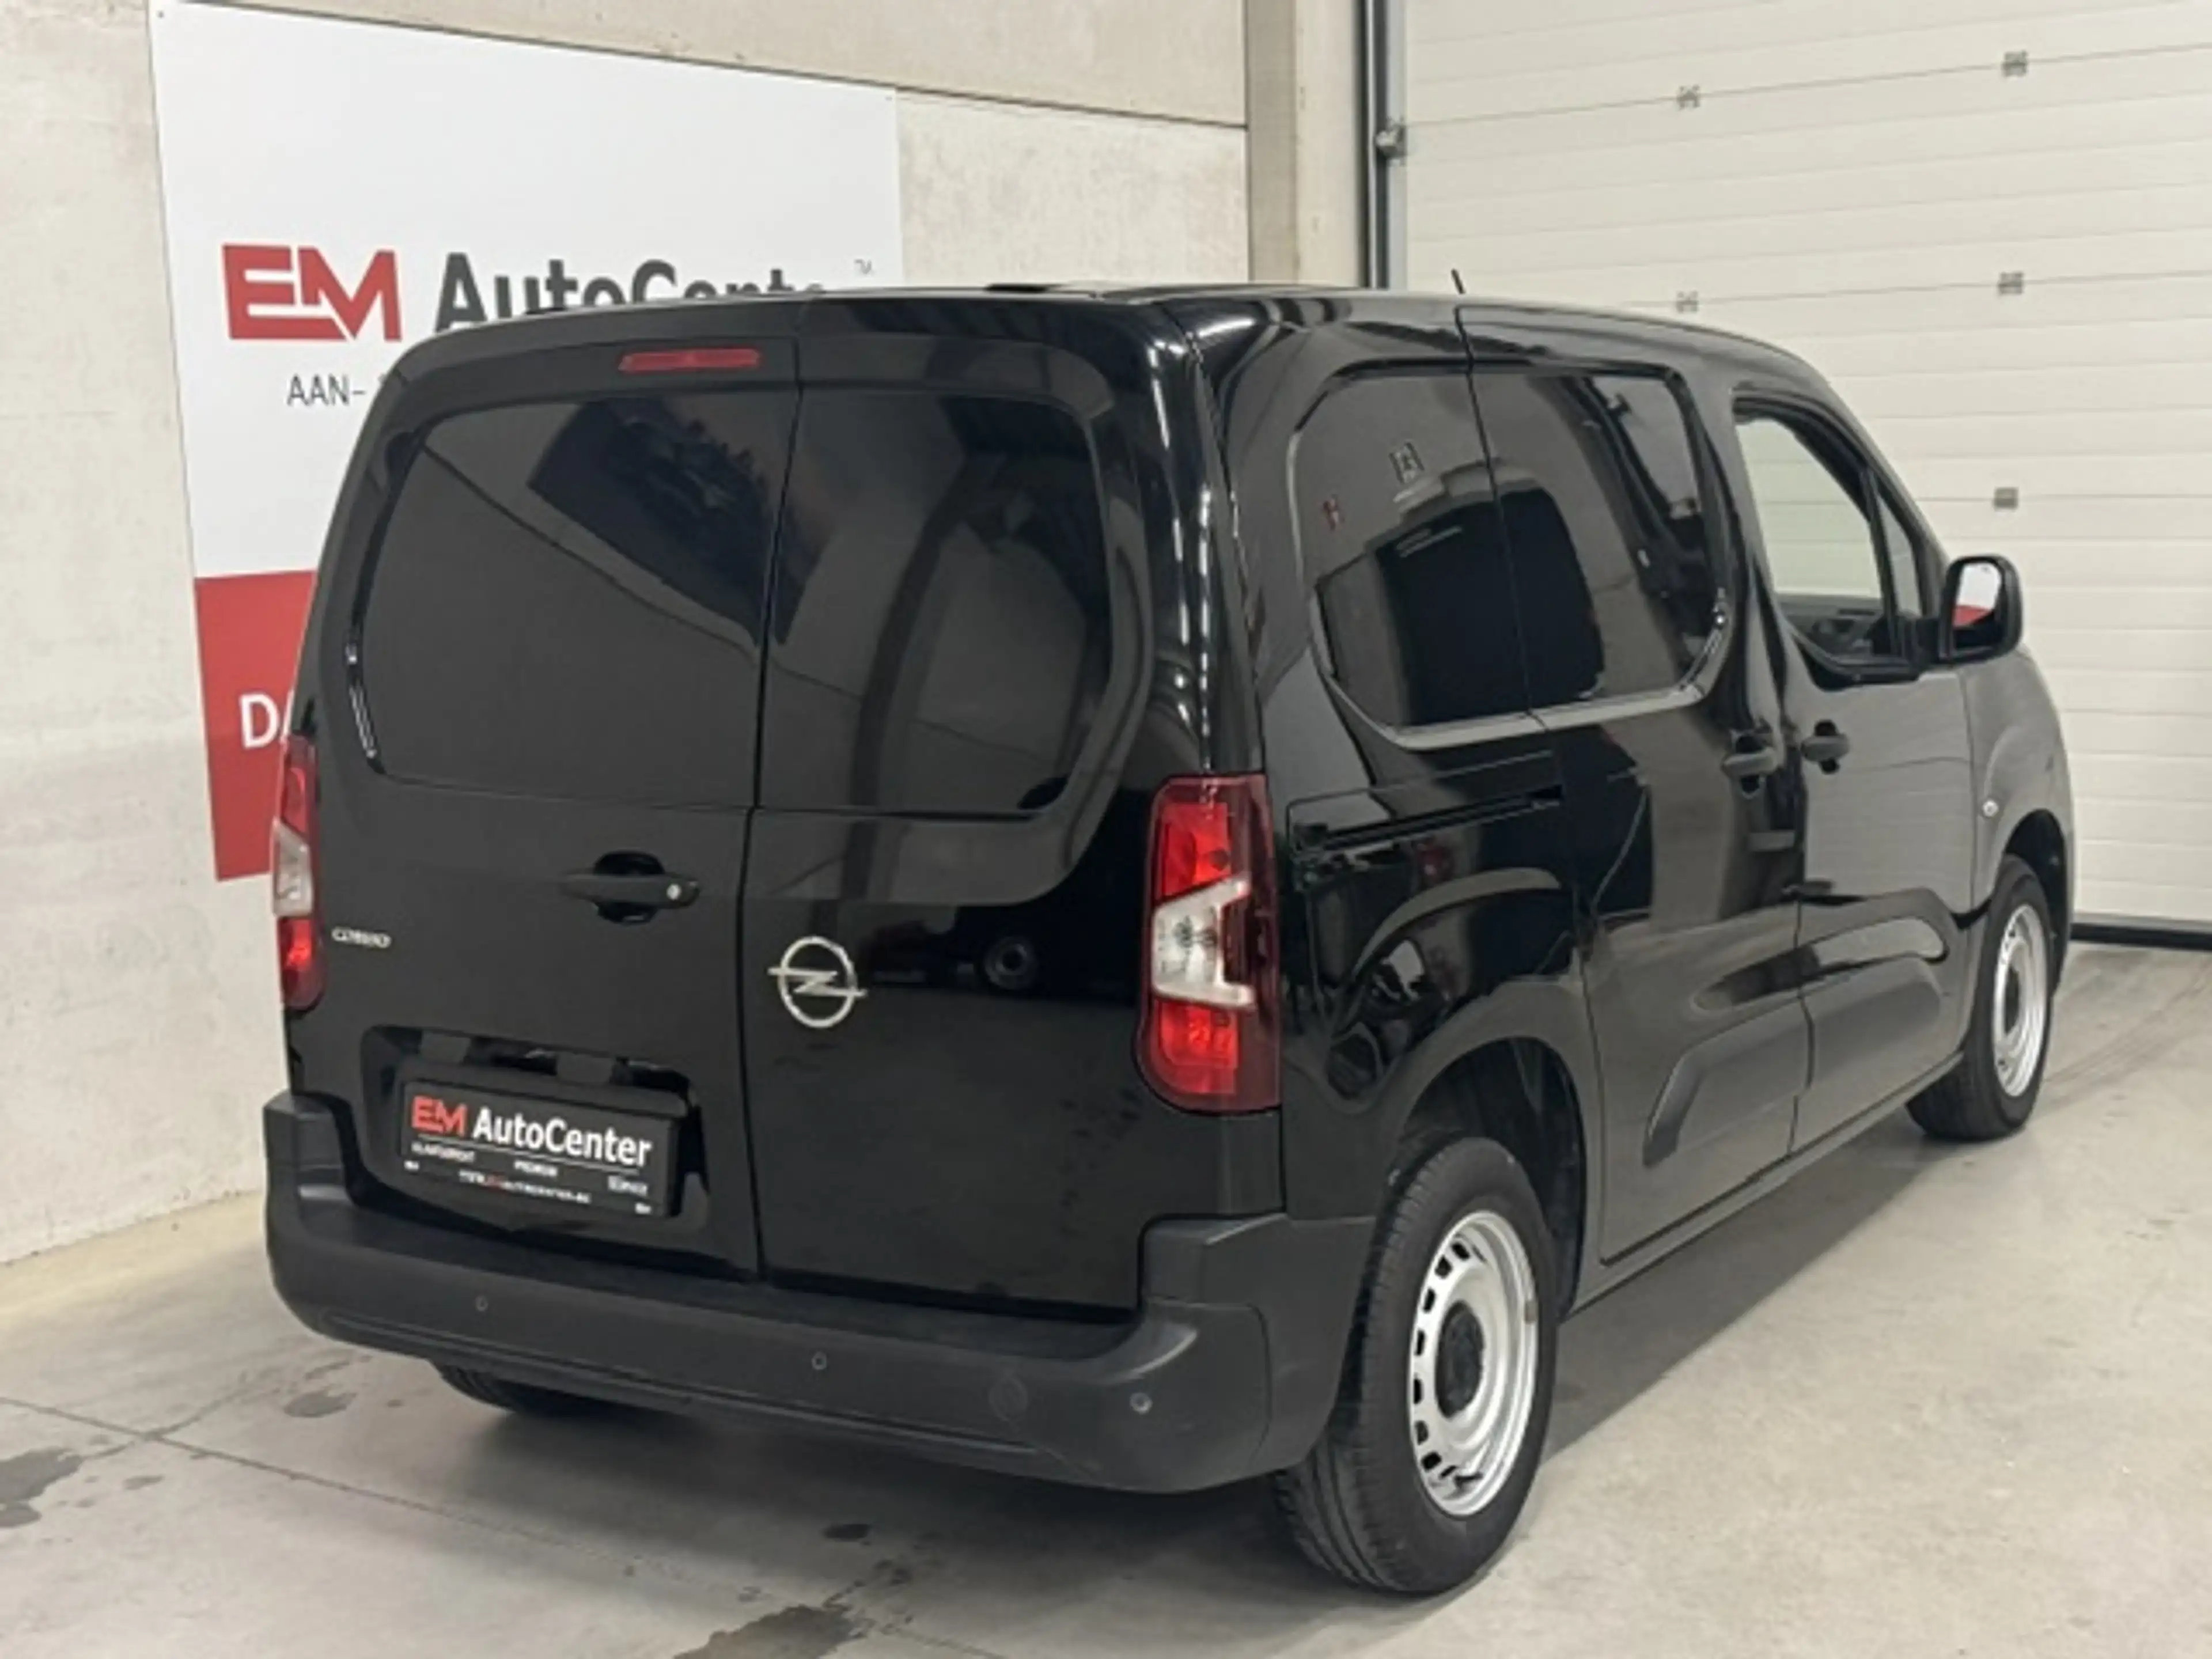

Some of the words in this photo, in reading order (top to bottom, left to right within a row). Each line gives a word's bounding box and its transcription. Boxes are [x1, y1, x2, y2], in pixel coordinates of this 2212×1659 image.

[222, 244, 402, 342] EM
[411, 1096, 468, 1138] EM
[472, 1105, 653, 1167] AutoCenter
